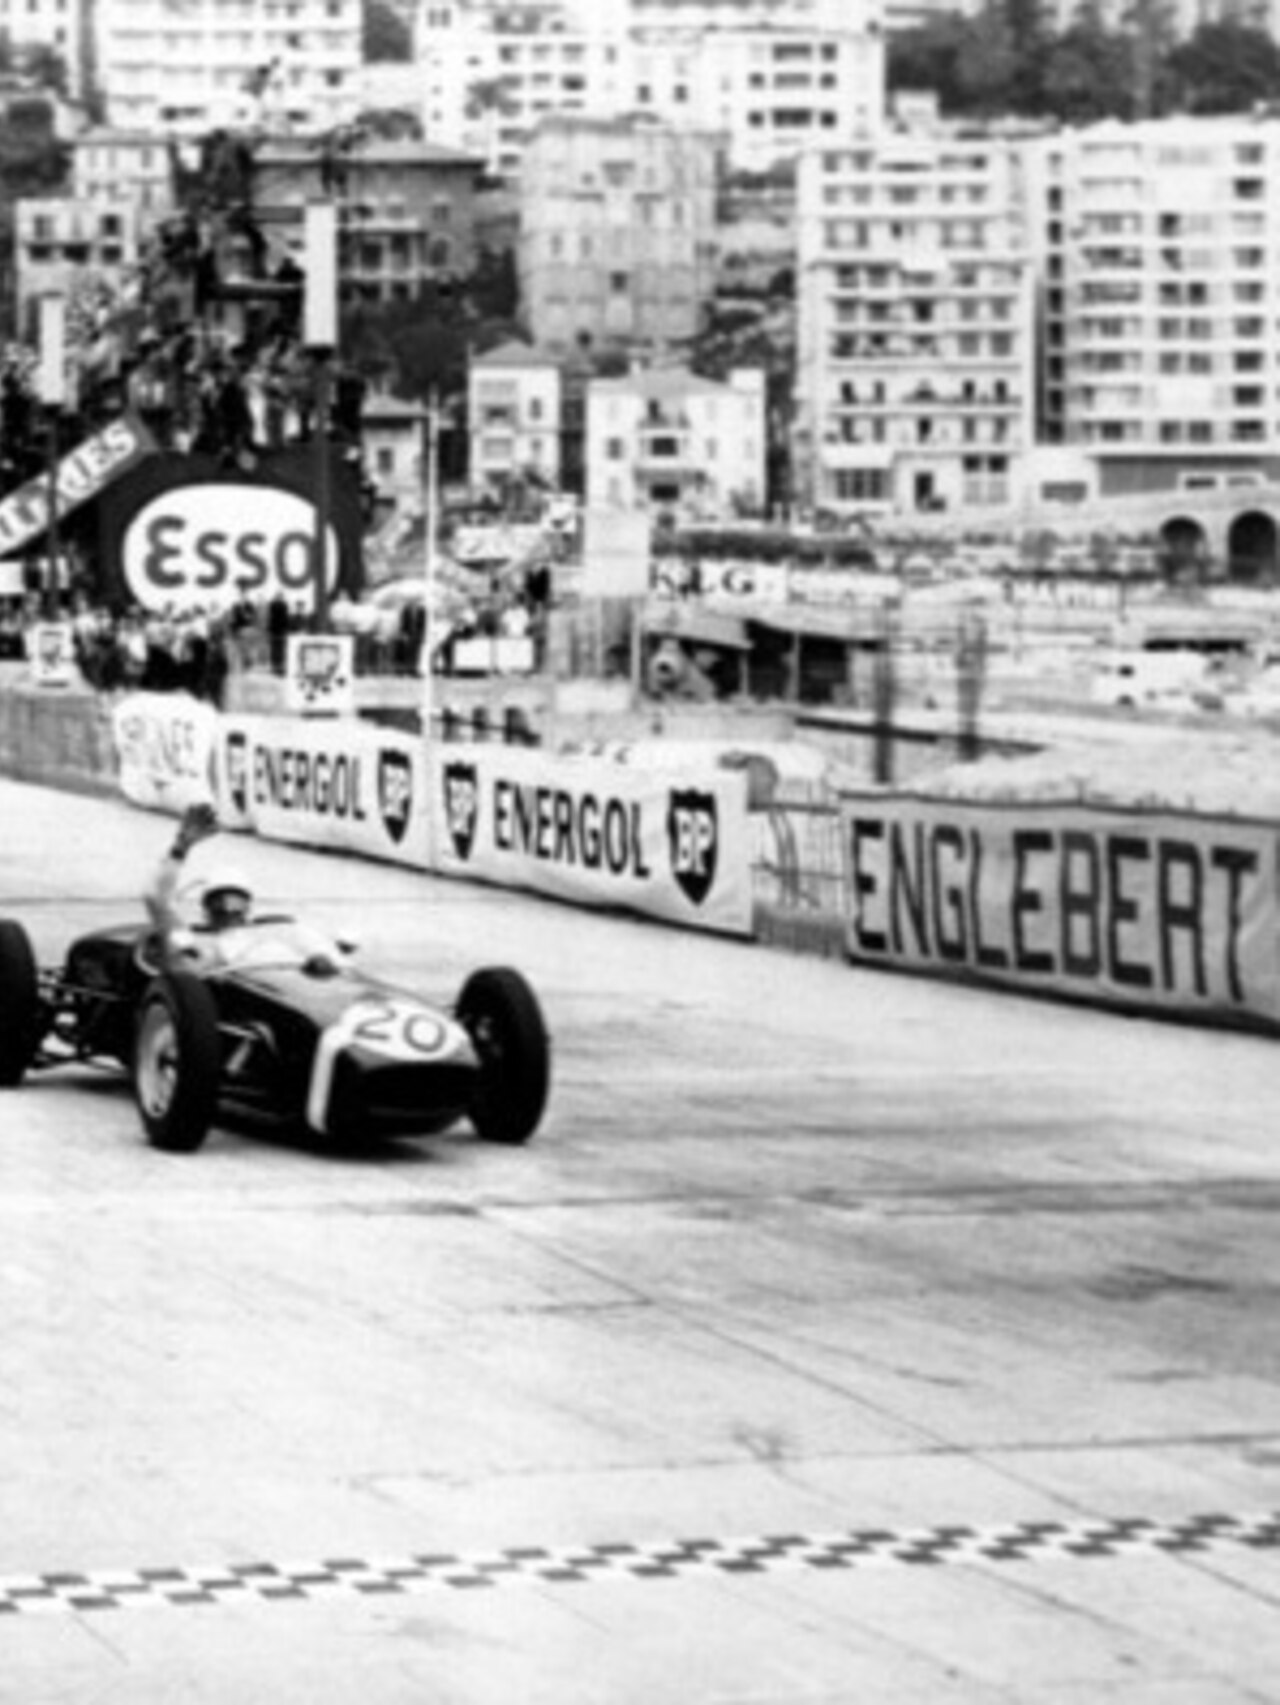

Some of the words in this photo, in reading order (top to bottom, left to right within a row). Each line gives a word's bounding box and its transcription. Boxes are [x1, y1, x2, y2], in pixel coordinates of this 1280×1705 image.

[142, 514, 320, 589] Esso
[254, 744, 367, 821] ENERGOL
[493, 778, 652, 880] ENERGOL
[673, 806, 716, 876] BP
[851, 818, 1259, 1004] ENGLEBERT
[354, 993, 447, 1053] 20
